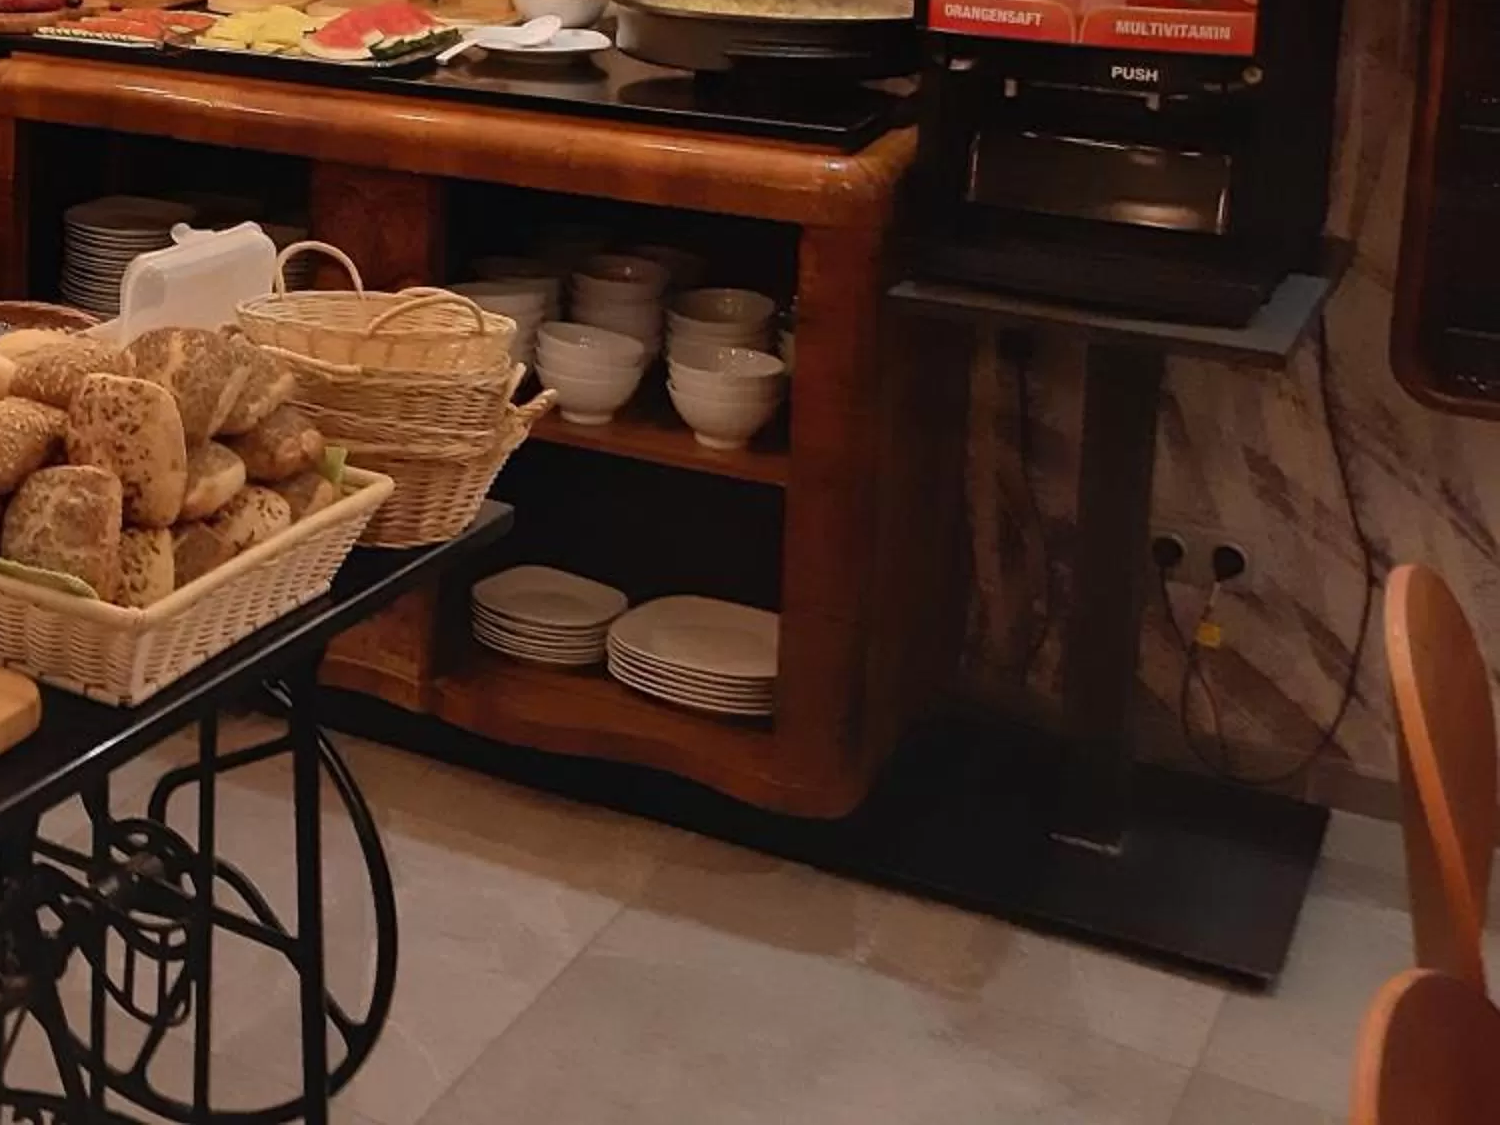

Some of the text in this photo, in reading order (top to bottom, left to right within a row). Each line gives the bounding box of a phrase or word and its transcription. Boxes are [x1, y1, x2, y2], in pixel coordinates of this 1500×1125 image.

[944, 2, 1044, 27] ORANGENSAFT
[1115, 20, 1231, 41] MULTIVITAMIN
[1111, 65, 1160, 83] PUSH
